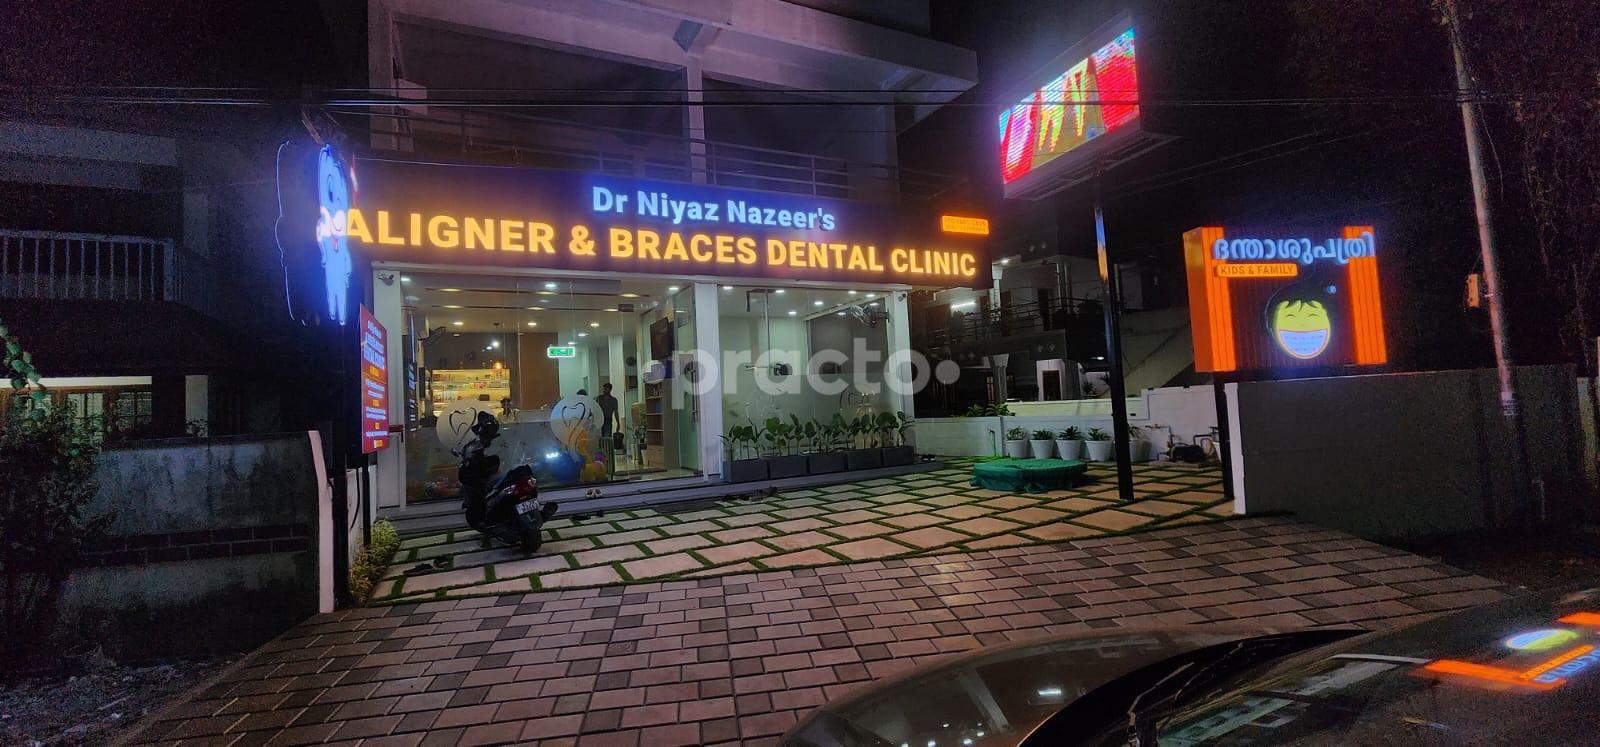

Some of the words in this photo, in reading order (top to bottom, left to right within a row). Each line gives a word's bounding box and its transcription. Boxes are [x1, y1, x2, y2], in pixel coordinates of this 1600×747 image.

[592, 186, 627, 213] Dr
[638, 190, 719, 225] Niyaz
[727, 200, 835, 230] Nazeer's
[345, 208, 556, 254] ALIGNER
[569, 225, 596, 256] &
[609, 228, 757, 264] BRACES
[767, 239, 884, 272] DENTAL
[891, 248, 976, 277] CLINIC
[1220, 265, 1245, 275] KIDS
[1257, 264, 1295, 275] FAMILY
